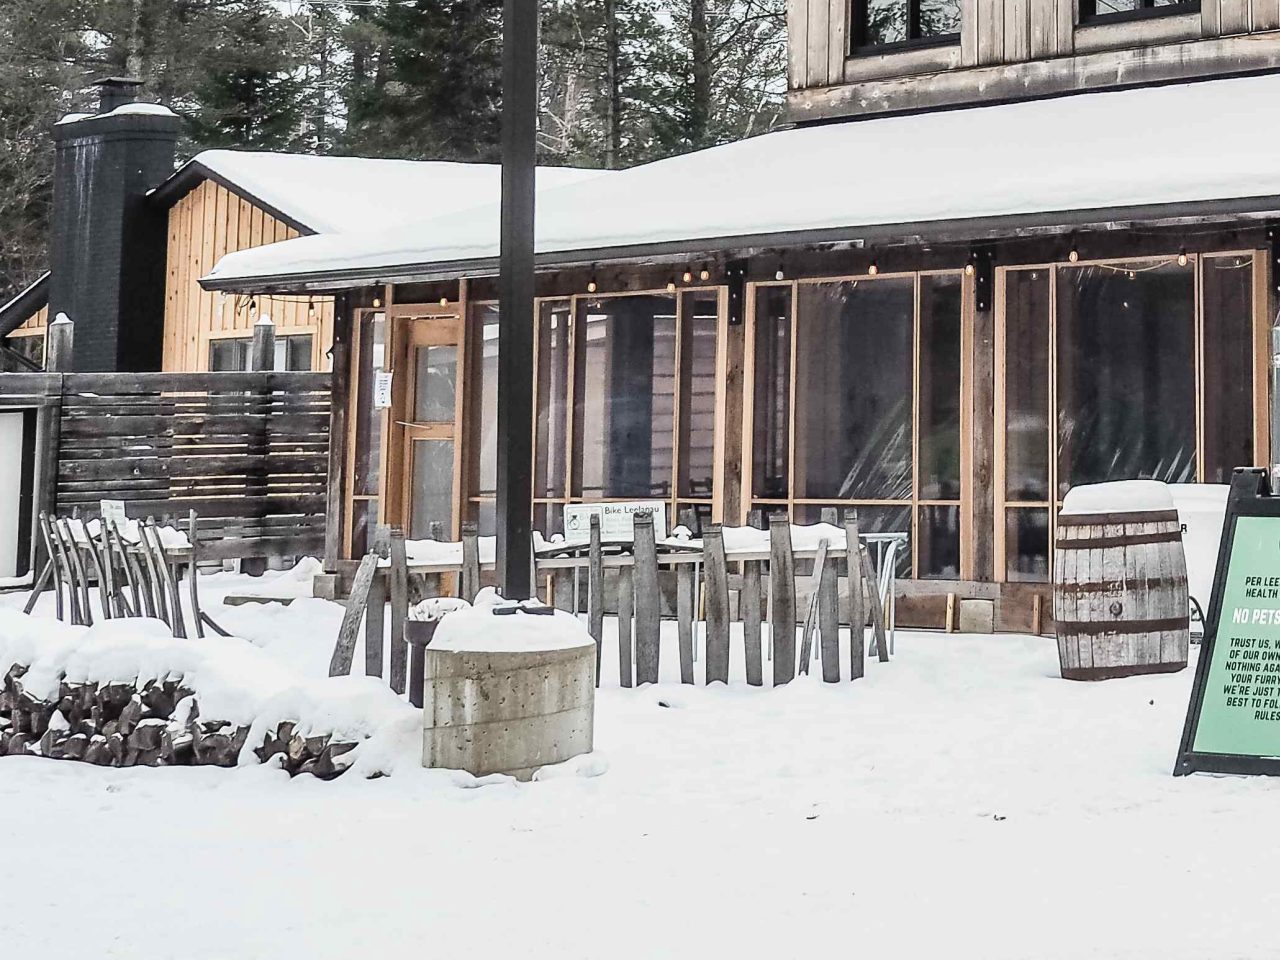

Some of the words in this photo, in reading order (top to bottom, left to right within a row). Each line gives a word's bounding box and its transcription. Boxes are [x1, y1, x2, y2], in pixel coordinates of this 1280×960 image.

[604, 506, 622, 515] Bike
[1245, 576, 1262, 586] PER
[1246, 588, 1278, 599] HEALTH
[1232, 608, 1249, 624] NO
[1230, 638, 1256, 648] TRUST
[1258, 639, 1271, 650] US,
[1229, 650, 1240, 659] OF
[1243, 650, 1259, 660] OUR
[1261, 651, 1280, 661] OWN
[1225, 661, 1261, 672] NOTHING
[1231, 673, 1252, 683] YOUR
[1223, 685, 1250, 696] WE'RE
[1252, 687, 1274, 696] JUST
[1226, 697, 1249, 707] BEST
[1251, 698, 1261, 708] TO
